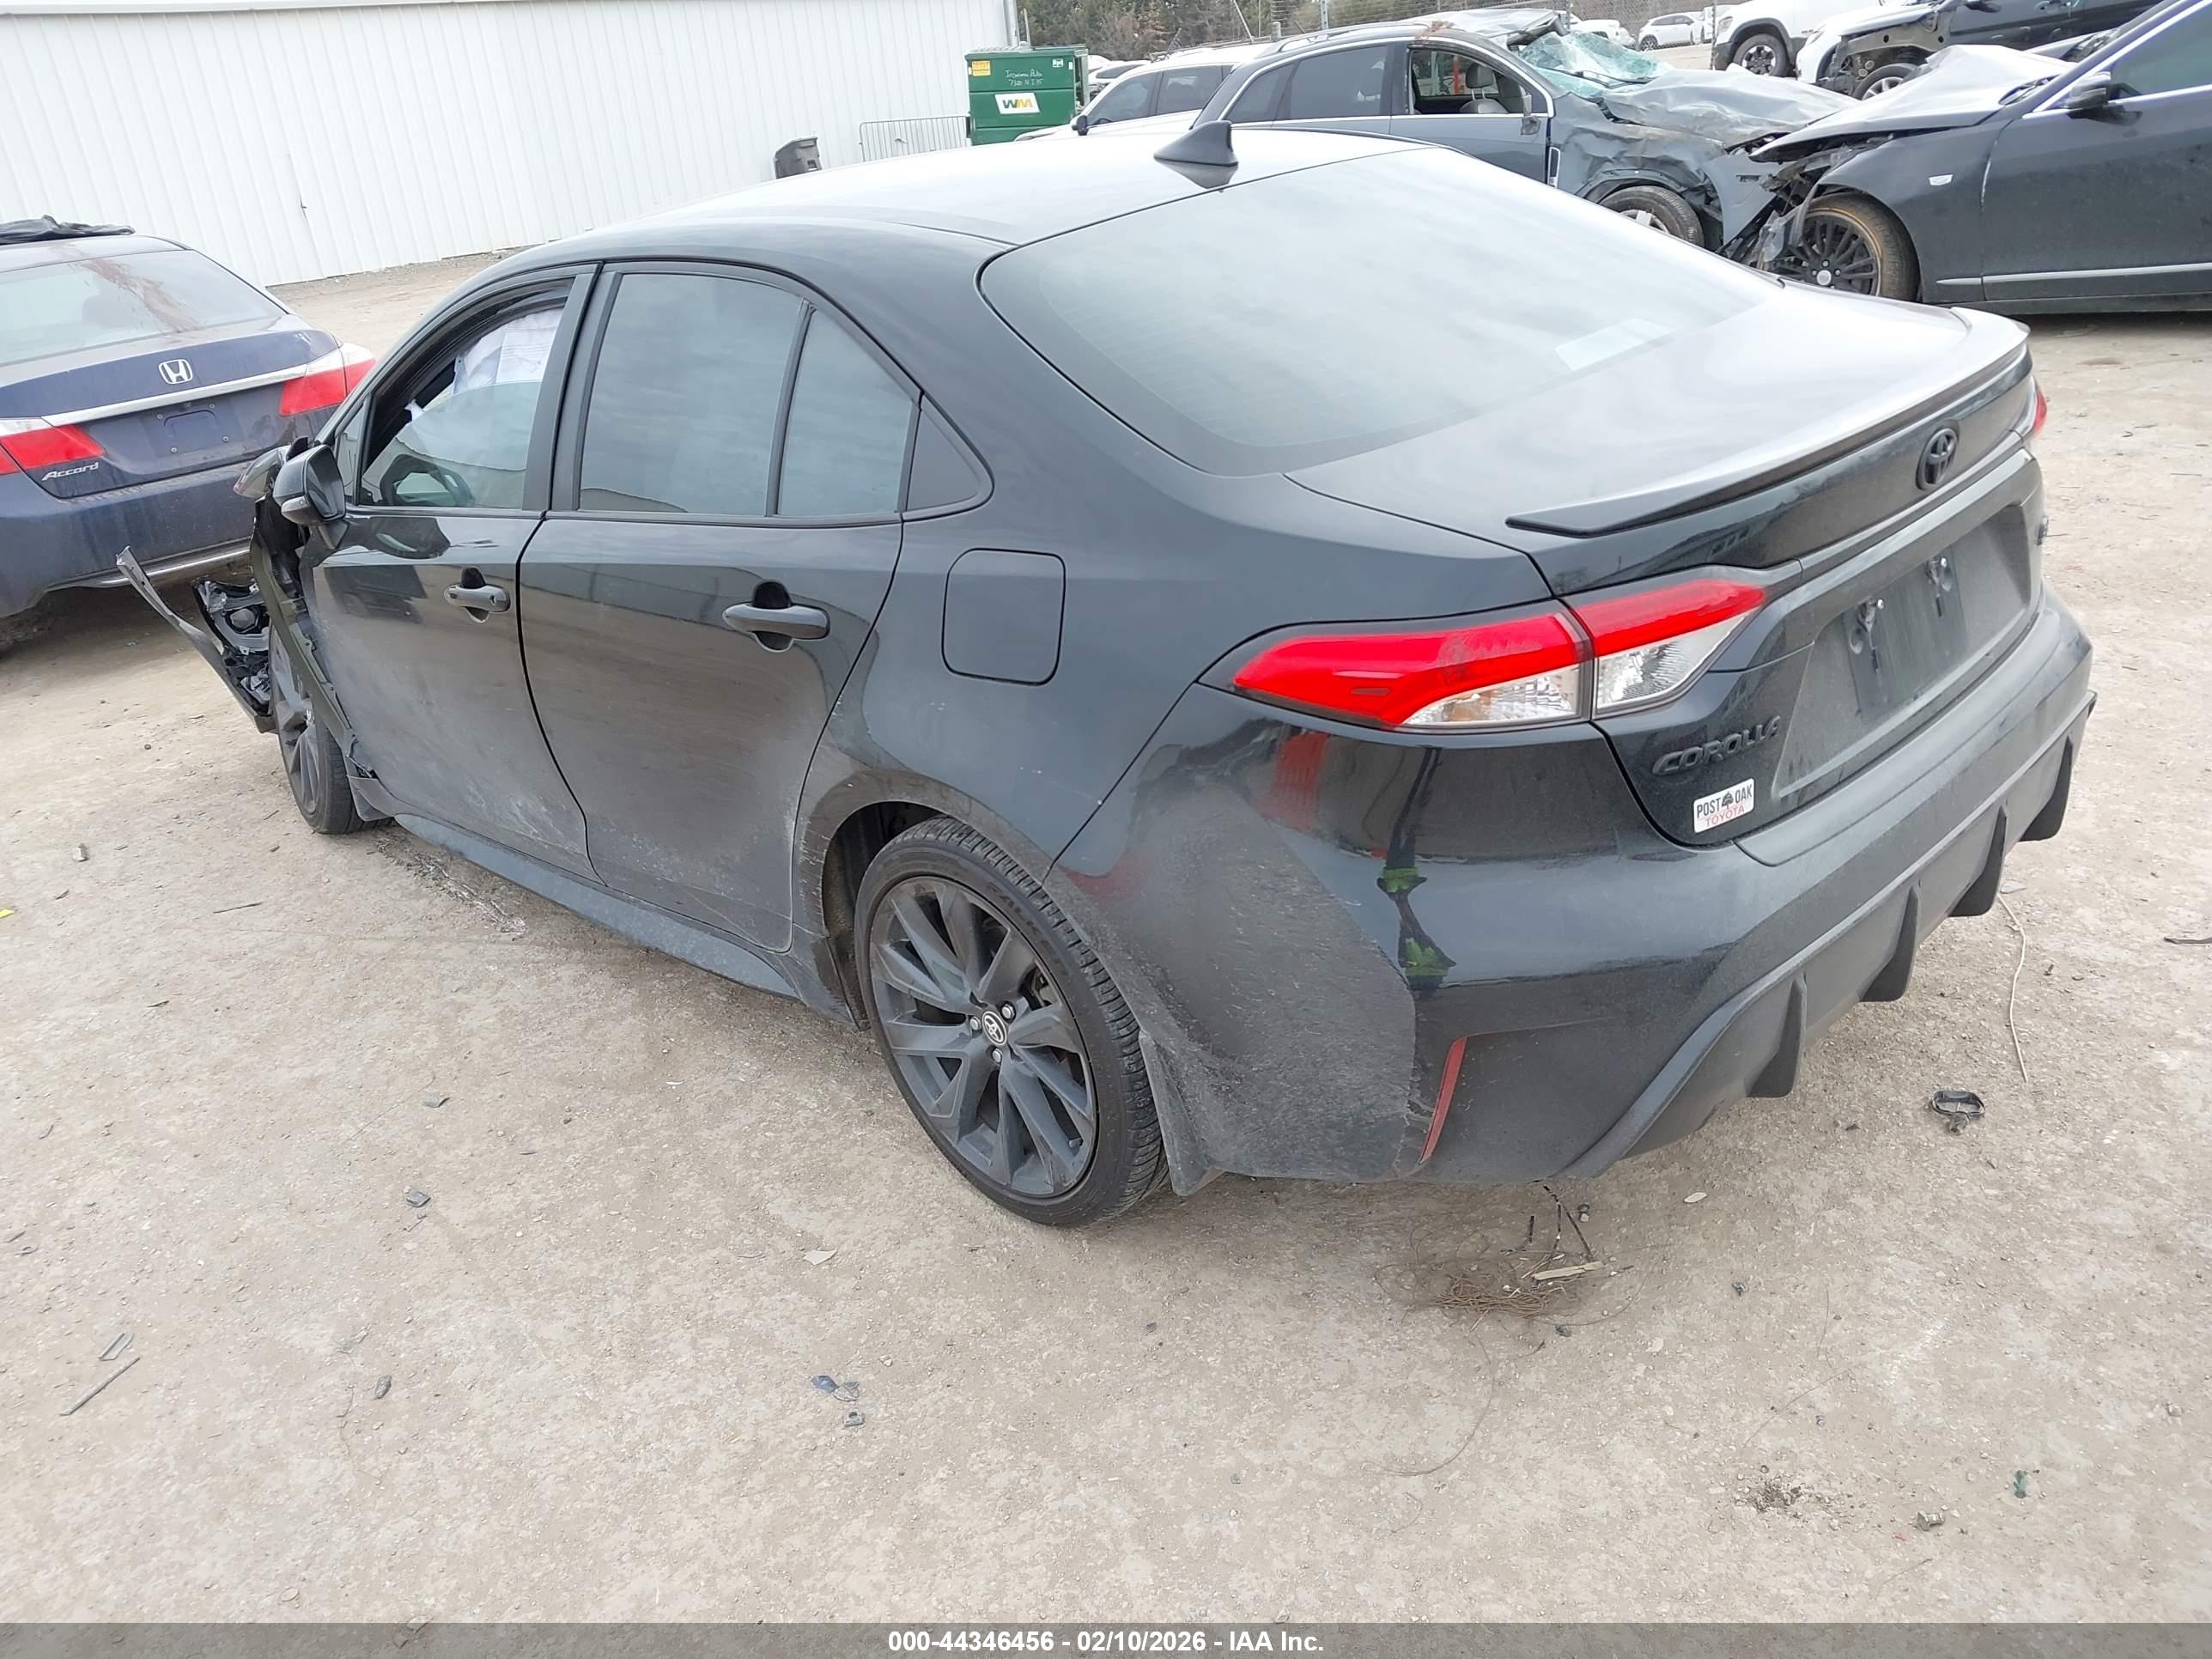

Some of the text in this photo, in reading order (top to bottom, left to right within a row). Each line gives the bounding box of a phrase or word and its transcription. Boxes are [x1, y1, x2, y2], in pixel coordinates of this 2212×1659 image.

[1002, 99, 1033, 109] WM
[41, 462, 99, 481] Accord
[1652, 714, 1781, 775] COROLLA
[1696, 784, 1753, 818] POST OAK
[1705, 805, 1745, 827] TOYOTA
